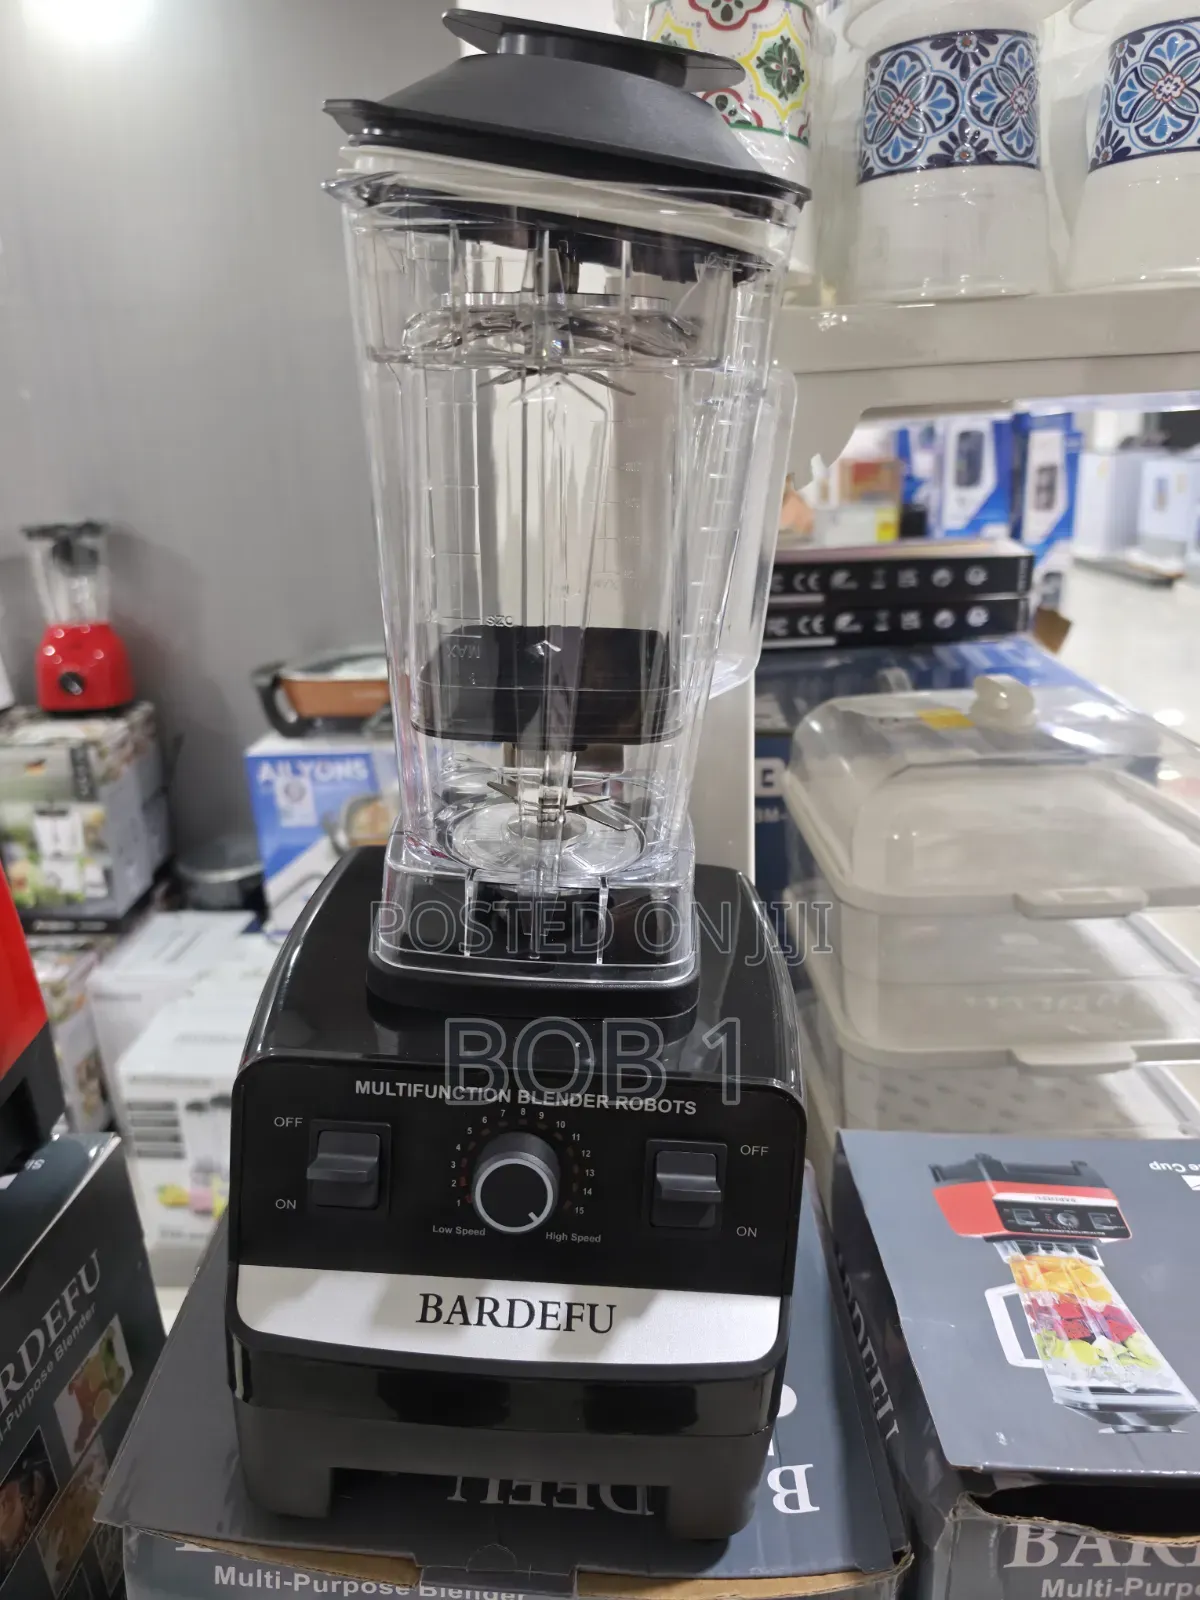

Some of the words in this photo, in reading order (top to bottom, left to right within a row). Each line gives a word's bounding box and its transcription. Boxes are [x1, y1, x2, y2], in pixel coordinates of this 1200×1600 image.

[355, 1080, 511, 1103] MULTIFUNCTION
[517, 1089, 610, 1109] BLENDER
[615, 1096, 697, 1115] ROBOTS
[500, 1109, 506, 1117] 7
[520, 1108, 526, 1116] 8
[539, 1111, 545, 1119] 9
[273, 1116, 304, 1128] OFF
[482, 1116, 488, 1124] 6
[556, 1120, 566, 1129] 10
[572, 1133, 581, 1141] 11
[740, 1144, 769, 1156] OFF
[450, 1161, 456, 1169] 3
[1148, 1160, 1187, 1173] Cup
[585, 1169, 595, 1177] 13
[275, 1198, 297, 1210] ON
[575, 1206, 584, 1215] 15
[432, 1225, 453, 1234] Low
[455, 1226, 486, 1237] Speed
[546, 1231, 568, 1242] High
[570, 1233, 602, 1243] Speed
[736, 1225, 758, 1238] ON
[415, 1293, 617, 1334] BARDEFU
[54, 1302, 96, 1363] Blender
[1002, 1523, 1200, 1568] BAR
